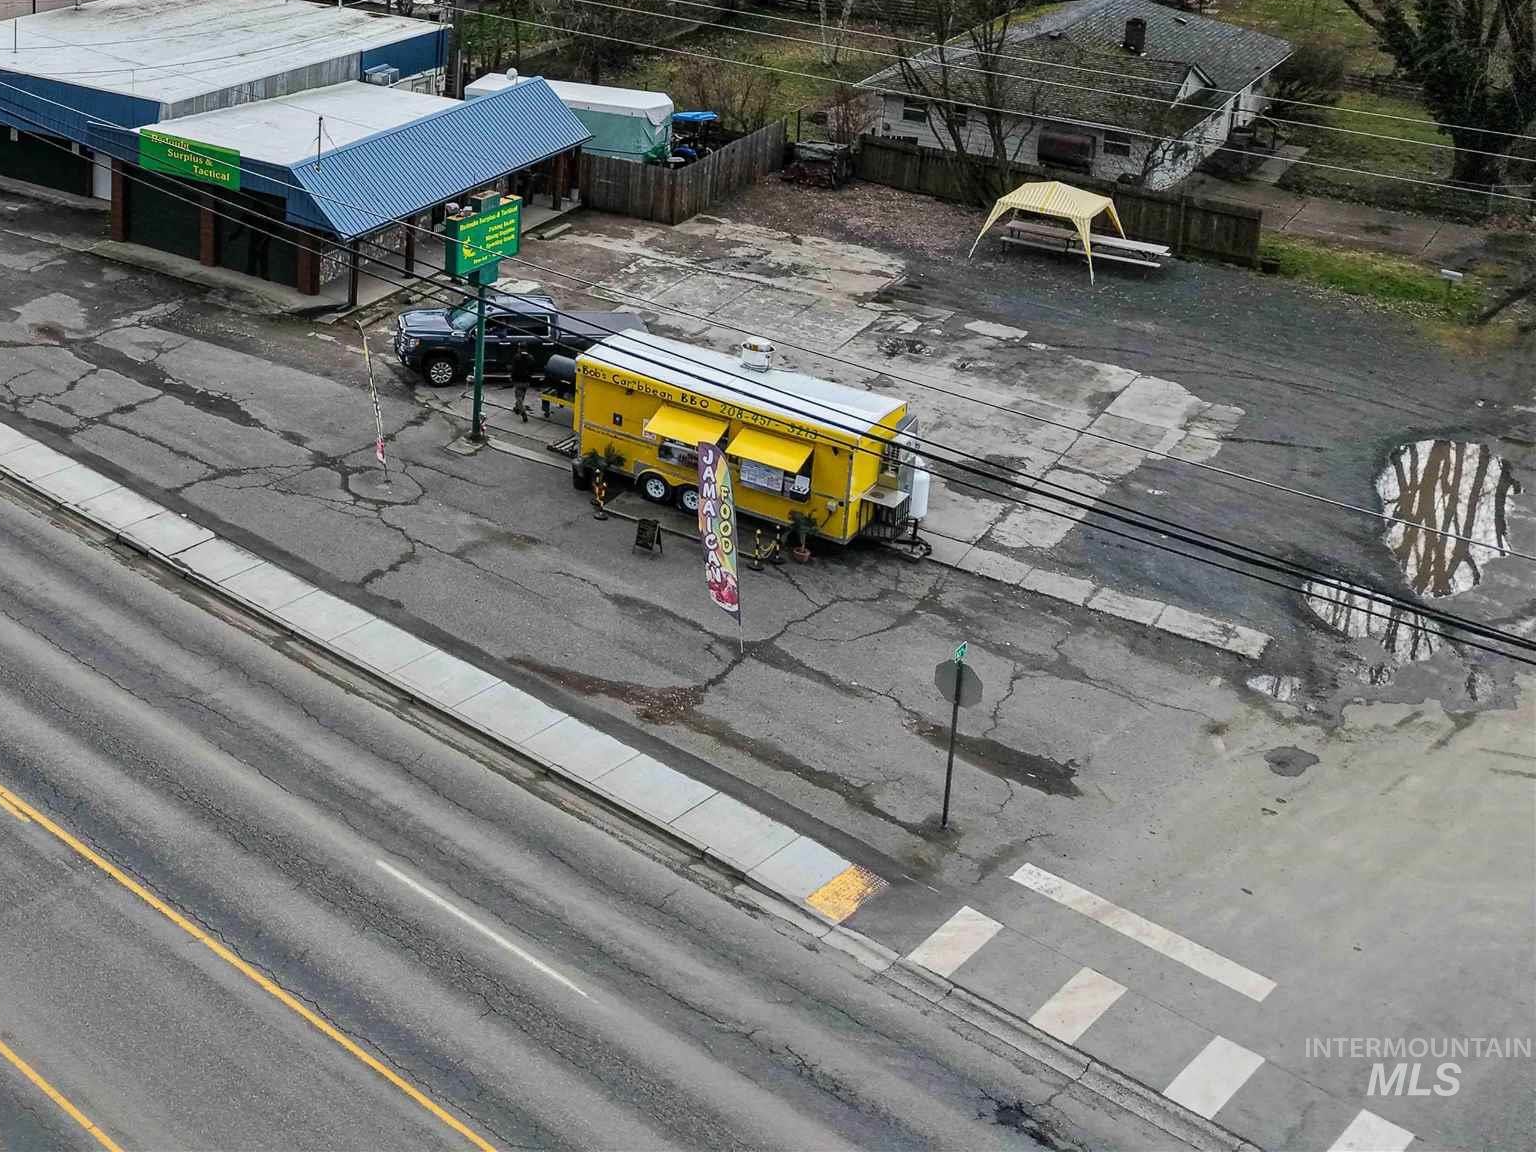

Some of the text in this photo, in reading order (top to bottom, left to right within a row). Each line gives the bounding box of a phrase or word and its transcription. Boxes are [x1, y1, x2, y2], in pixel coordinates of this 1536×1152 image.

[167, 149, 213, 167] Surplus &
[193, 165, 230, 181] Tactical
[702, 449, 721, 583] JAMAICAN
[719, 485, 732, 554] FOOD
